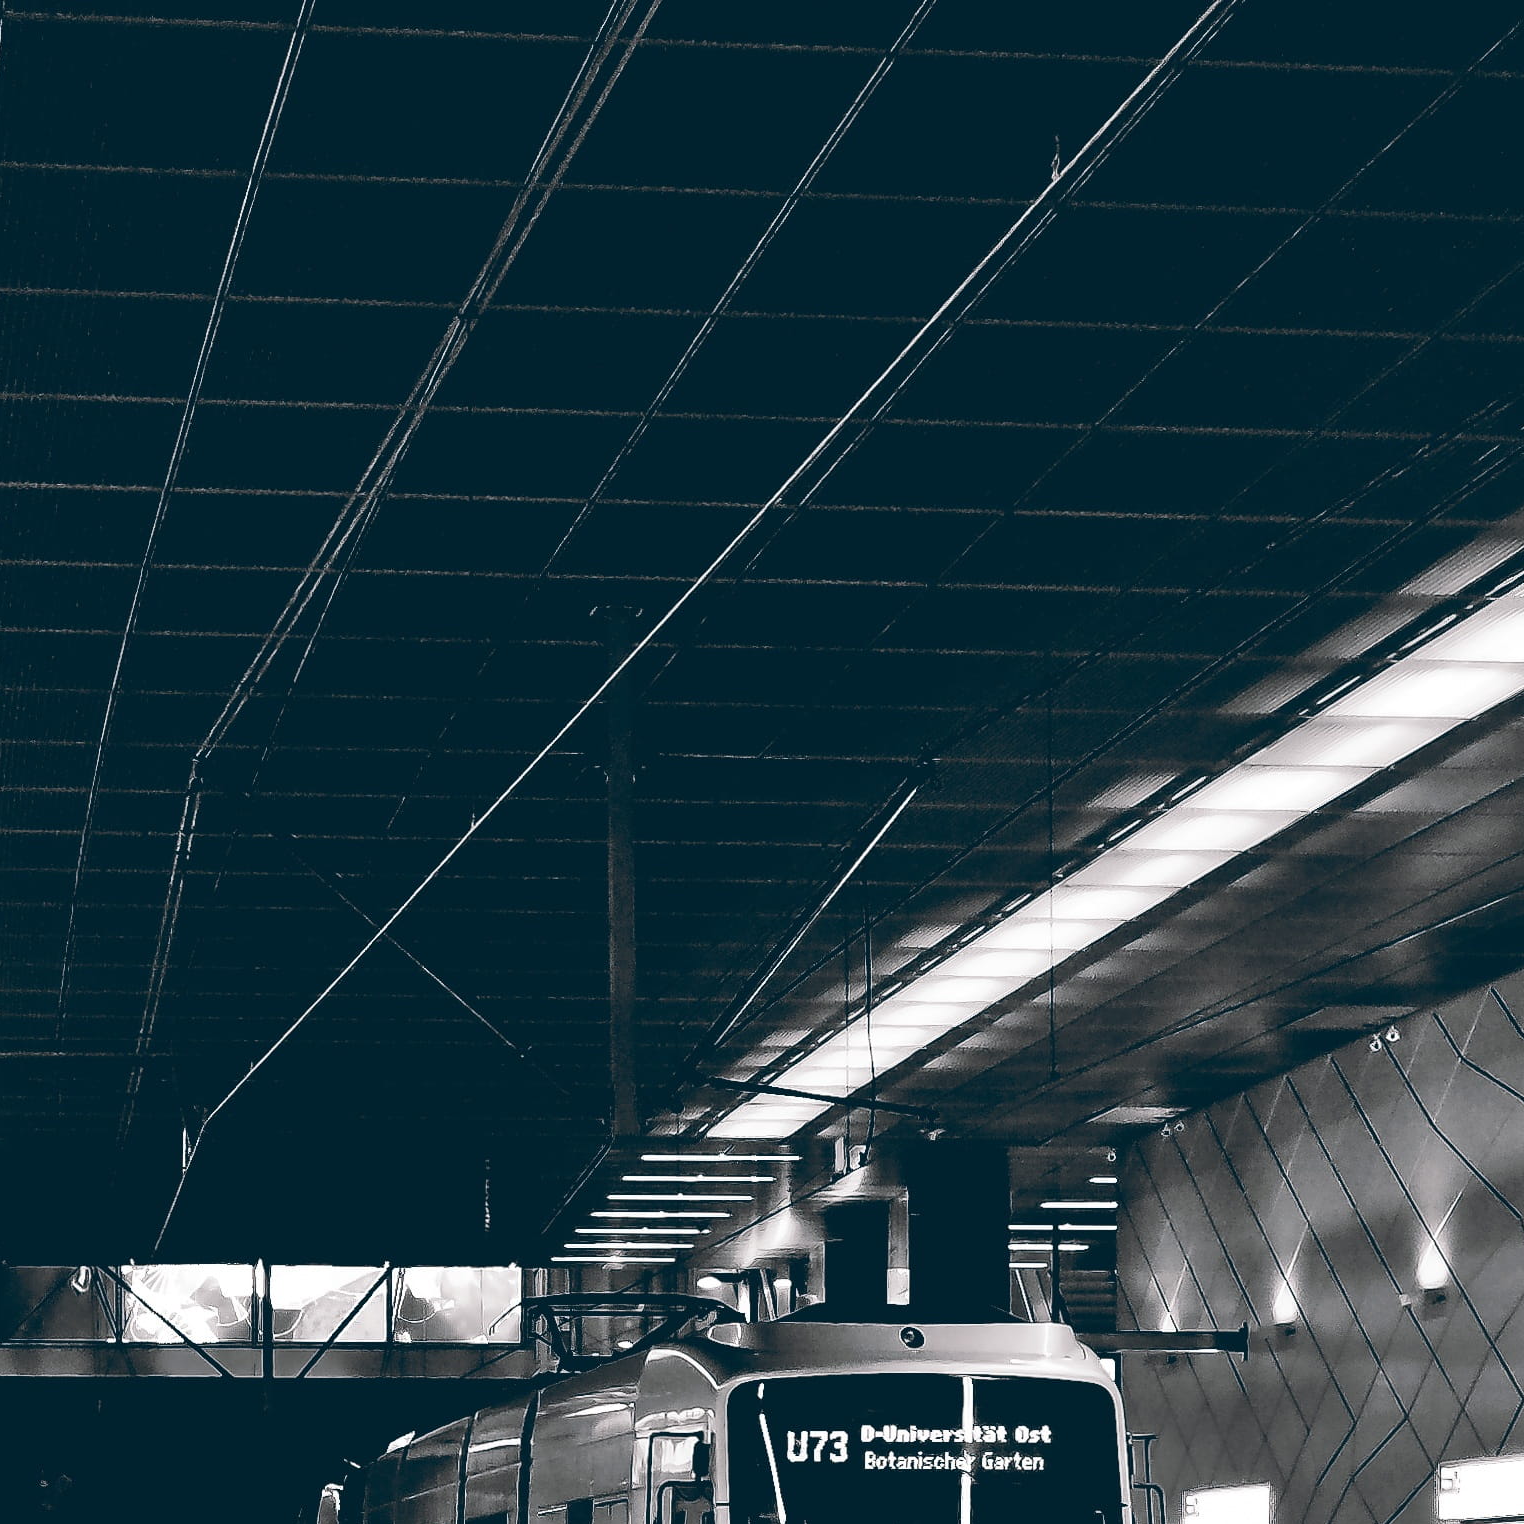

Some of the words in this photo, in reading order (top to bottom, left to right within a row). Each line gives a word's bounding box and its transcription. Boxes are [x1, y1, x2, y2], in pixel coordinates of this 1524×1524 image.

[860, 1424, 1008, 1443] D-Universtät
[1015, 1425, 1052, 1443] Ost
[787, 1430, 849, 1463] U73
[865, 1451, 975, 1471] Botanischer
[982, 1452, 1045, 1470] Garten
